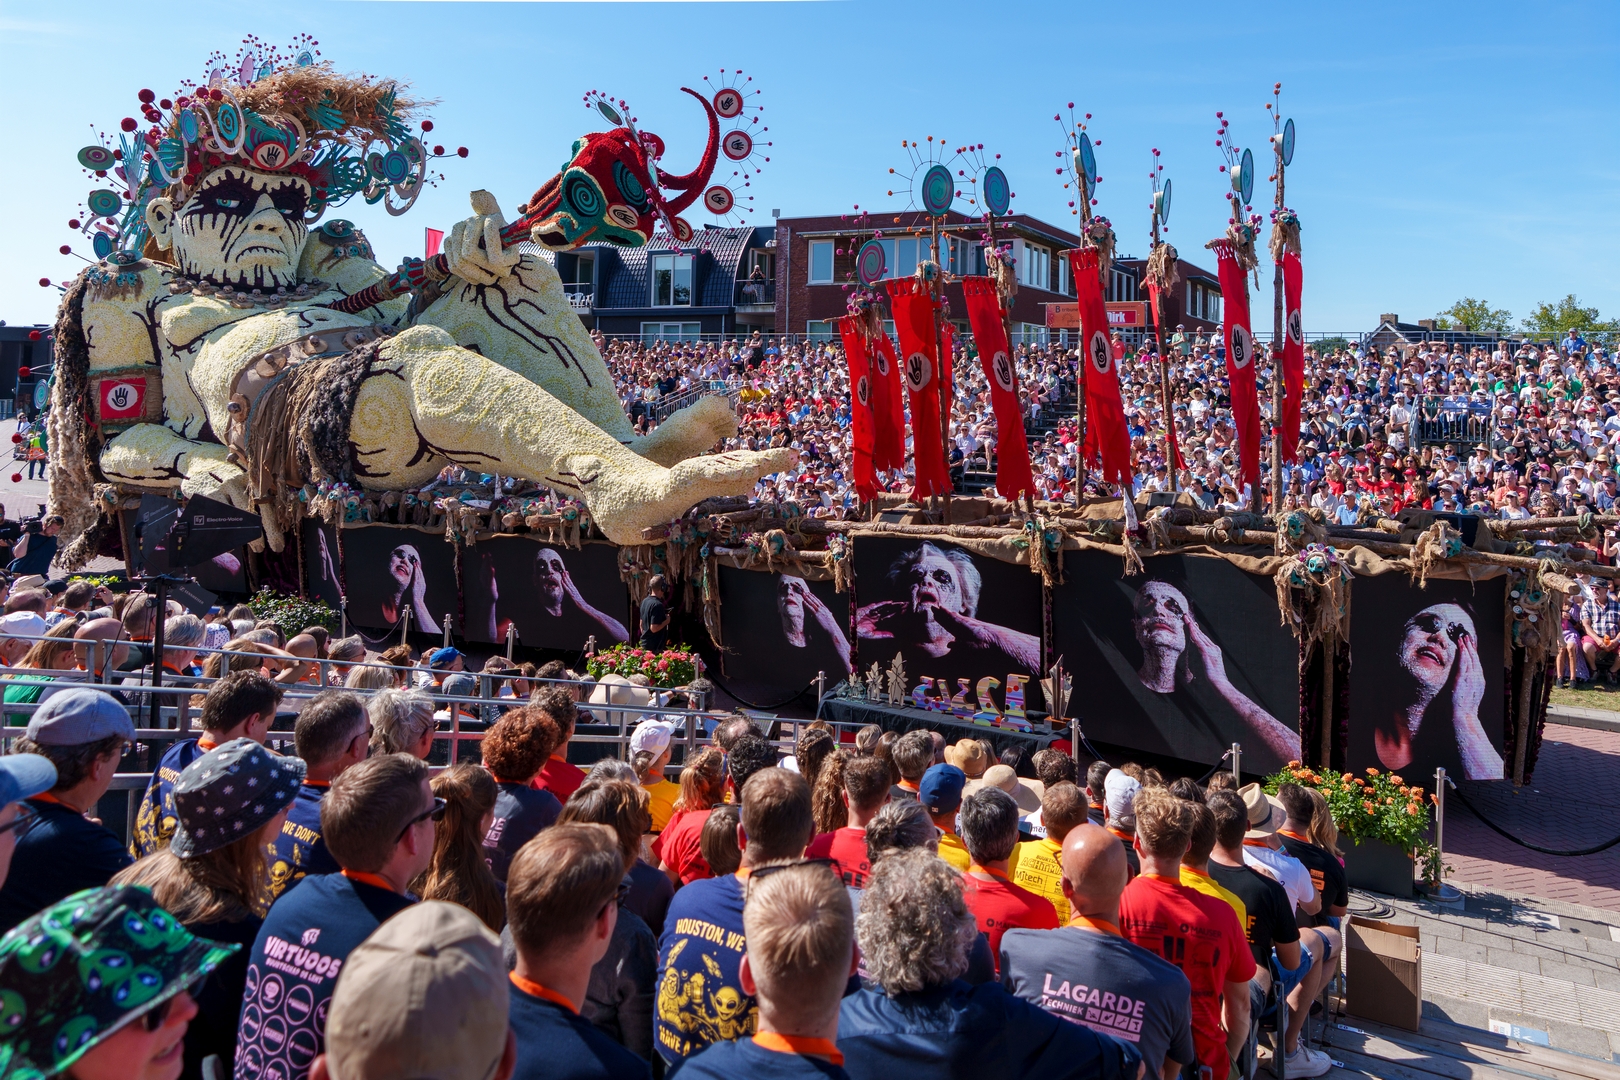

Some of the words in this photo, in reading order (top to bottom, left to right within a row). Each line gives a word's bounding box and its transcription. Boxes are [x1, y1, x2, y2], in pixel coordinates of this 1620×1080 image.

[1106, 311, 1126, 323] Dirk
[281, 820, 297, 836] WE
[294, 826, 321, 845] DON'T
[1015, 870, 1044, 885] Mjtech
[675, 918, 725, 946] HOUSTON,
[725, 931, 746, 952] WE
[1190, 926, 1222, 938] MAUSER
[263, 935, 342, 979] VIRTUOOS
[1041, 995, 1084, 1015] TECHNIEK
[1042, 973, 1146, 1018] LAGARDE
[658, 1025, 681, 1054] HAVE
